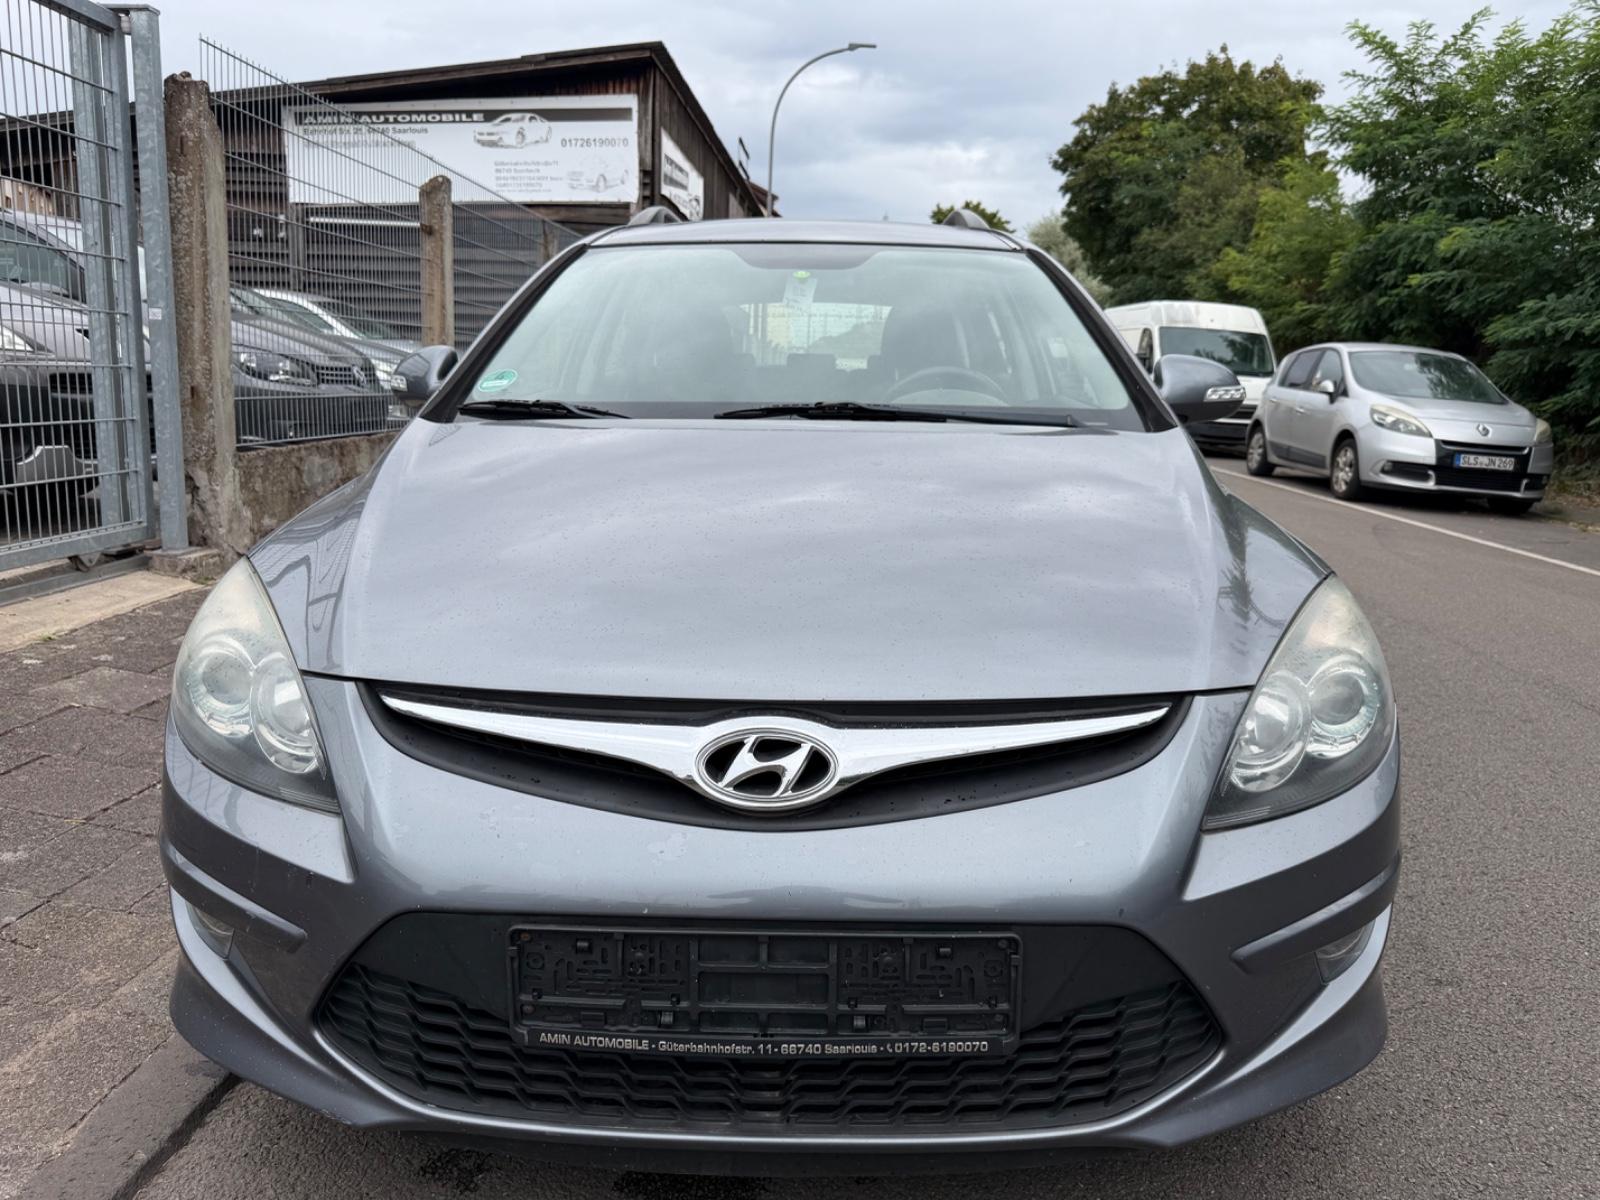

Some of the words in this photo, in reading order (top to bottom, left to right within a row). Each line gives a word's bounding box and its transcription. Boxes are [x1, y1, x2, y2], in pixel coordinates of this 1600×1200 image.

[358, 113, 485, 124] AUTOMOBILE
[1462, 455, 1480, 466] SLS
[1485, 457, 1497, 468] JN
[1497, 458, 1514, 469] 269
[539, 1032, 571, 1045] AMIN
[573, 1034, 649, 1050] AUTOMOBILE
[658, 1040, 755, 1054] Güterbahnhofstr.
[824, 1043, 878, 1054] Saarlouis
[895, 1041, 989, 1053] 0172-6190070
